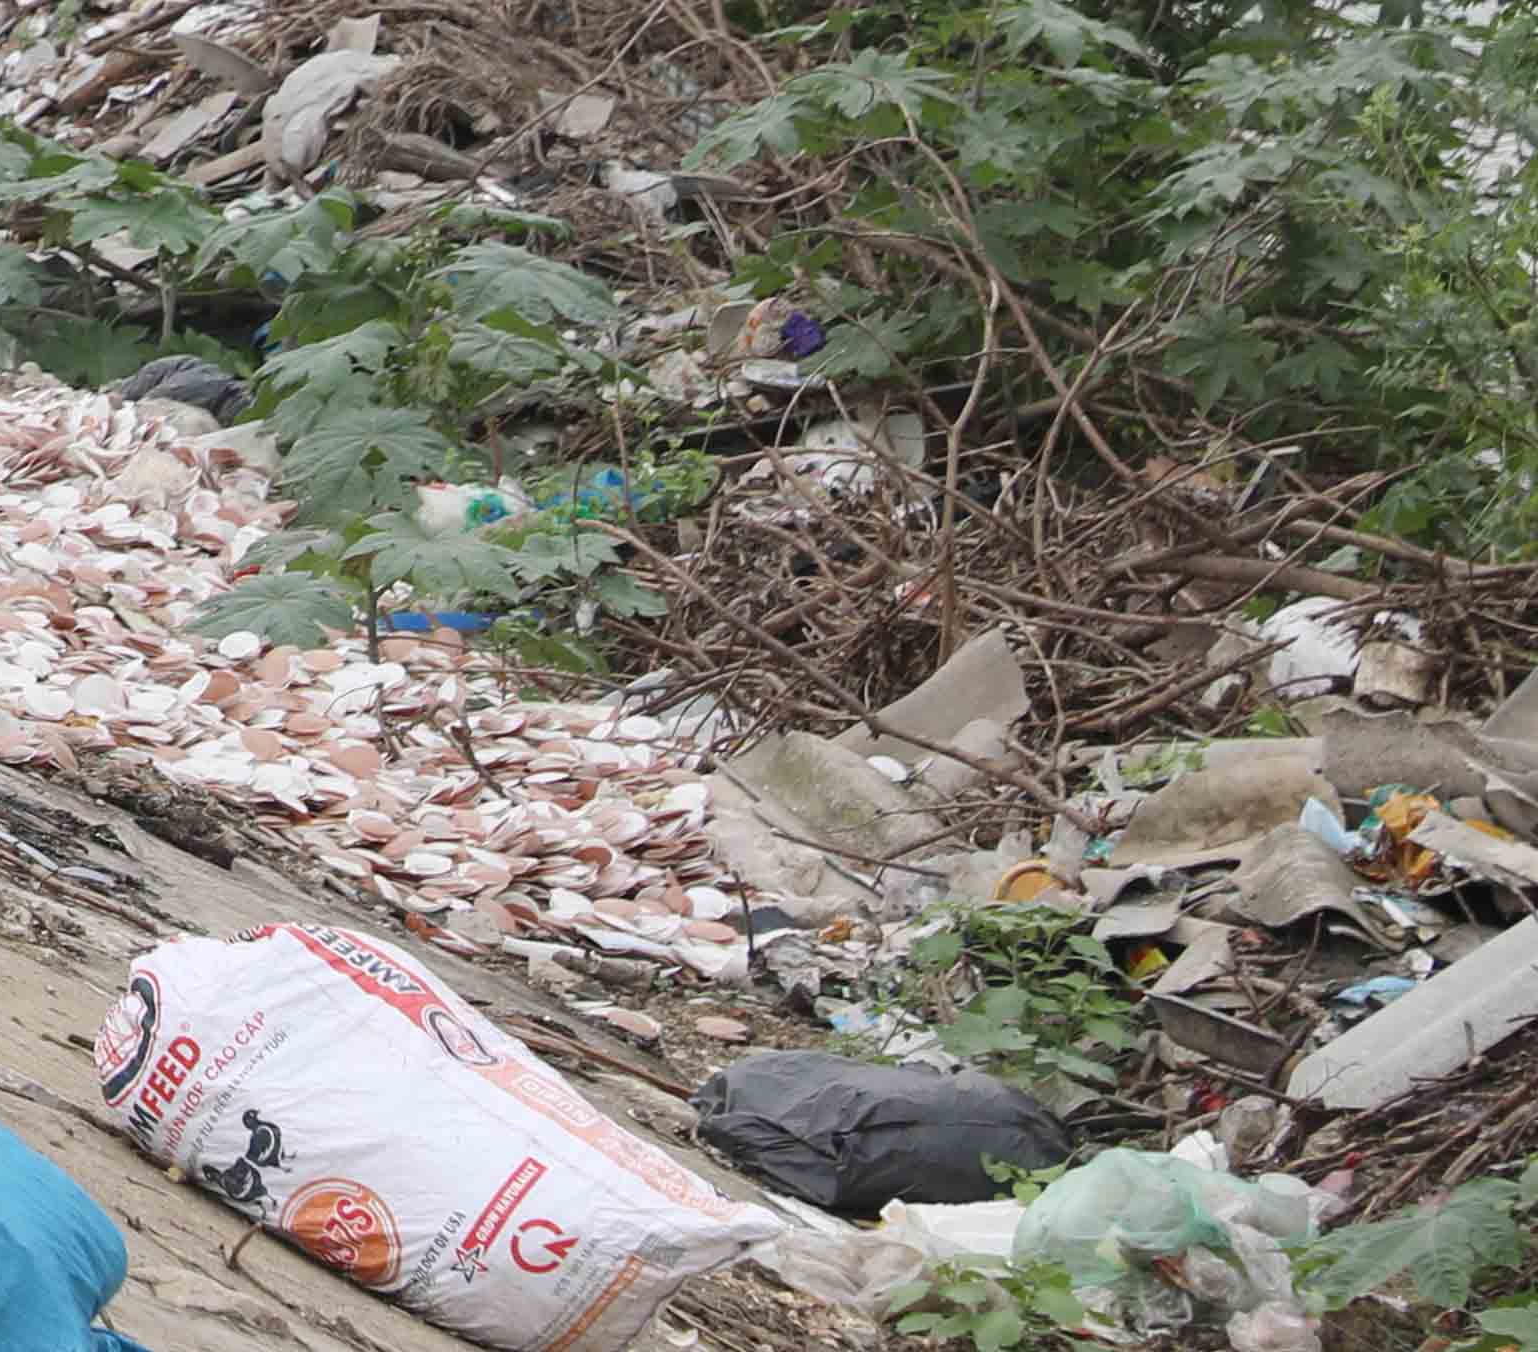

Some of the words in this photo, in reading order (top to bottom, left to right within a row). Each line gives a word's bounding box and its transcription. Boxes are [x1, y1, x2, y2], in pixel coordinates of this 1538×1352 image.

[204, 1045, 238, 1081] CAO
[474, 1211, 501, 1243] GROW
[493, 1162, 538, 1214] NATURALLY
[432, 1230, 450, 1249] OF
[442, 1210, 467, 1234] USA
